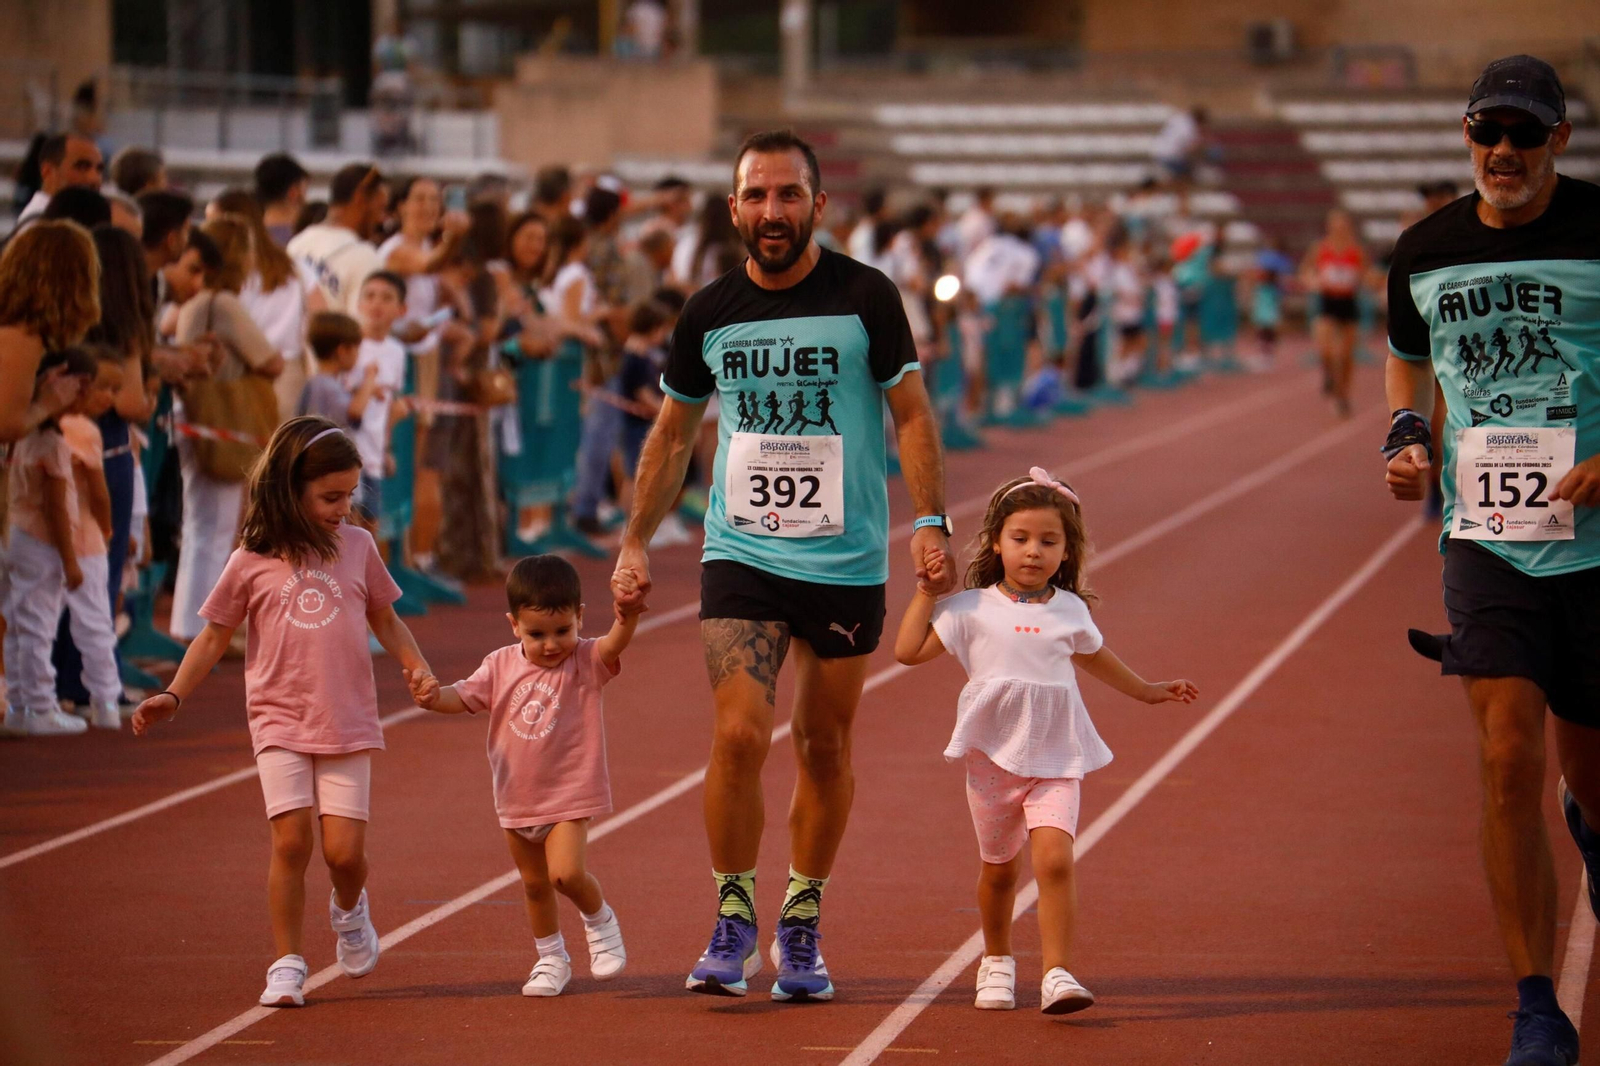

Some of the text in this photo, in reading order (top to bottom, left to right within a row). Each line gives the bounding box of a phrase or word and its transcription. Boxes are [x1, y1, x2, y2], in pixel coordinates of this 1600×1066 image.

[1446, 280, 1469, 290] CARRERA
[1469, 276, 1493, 287] CÓRDOBA
[1438, 282, 1562, 323] MUJER
[729, 340, 752, 348] CARRERA
[752, 338, 777, 347] CÓRDOBA
[722, 347, 839, 380] MUJER
[1515, 402, 1537, 410] cajasur
[760, 444, 810, 452] populares
[749, 474, 822, 508] 392
[1478, 472, 1549, 508] 152
[280, 569, 343, 605] STREET MONKEY
[284, 606, 340, 630] ORIGINAL BASIC
[539, 717, 558, 738] BASIC
